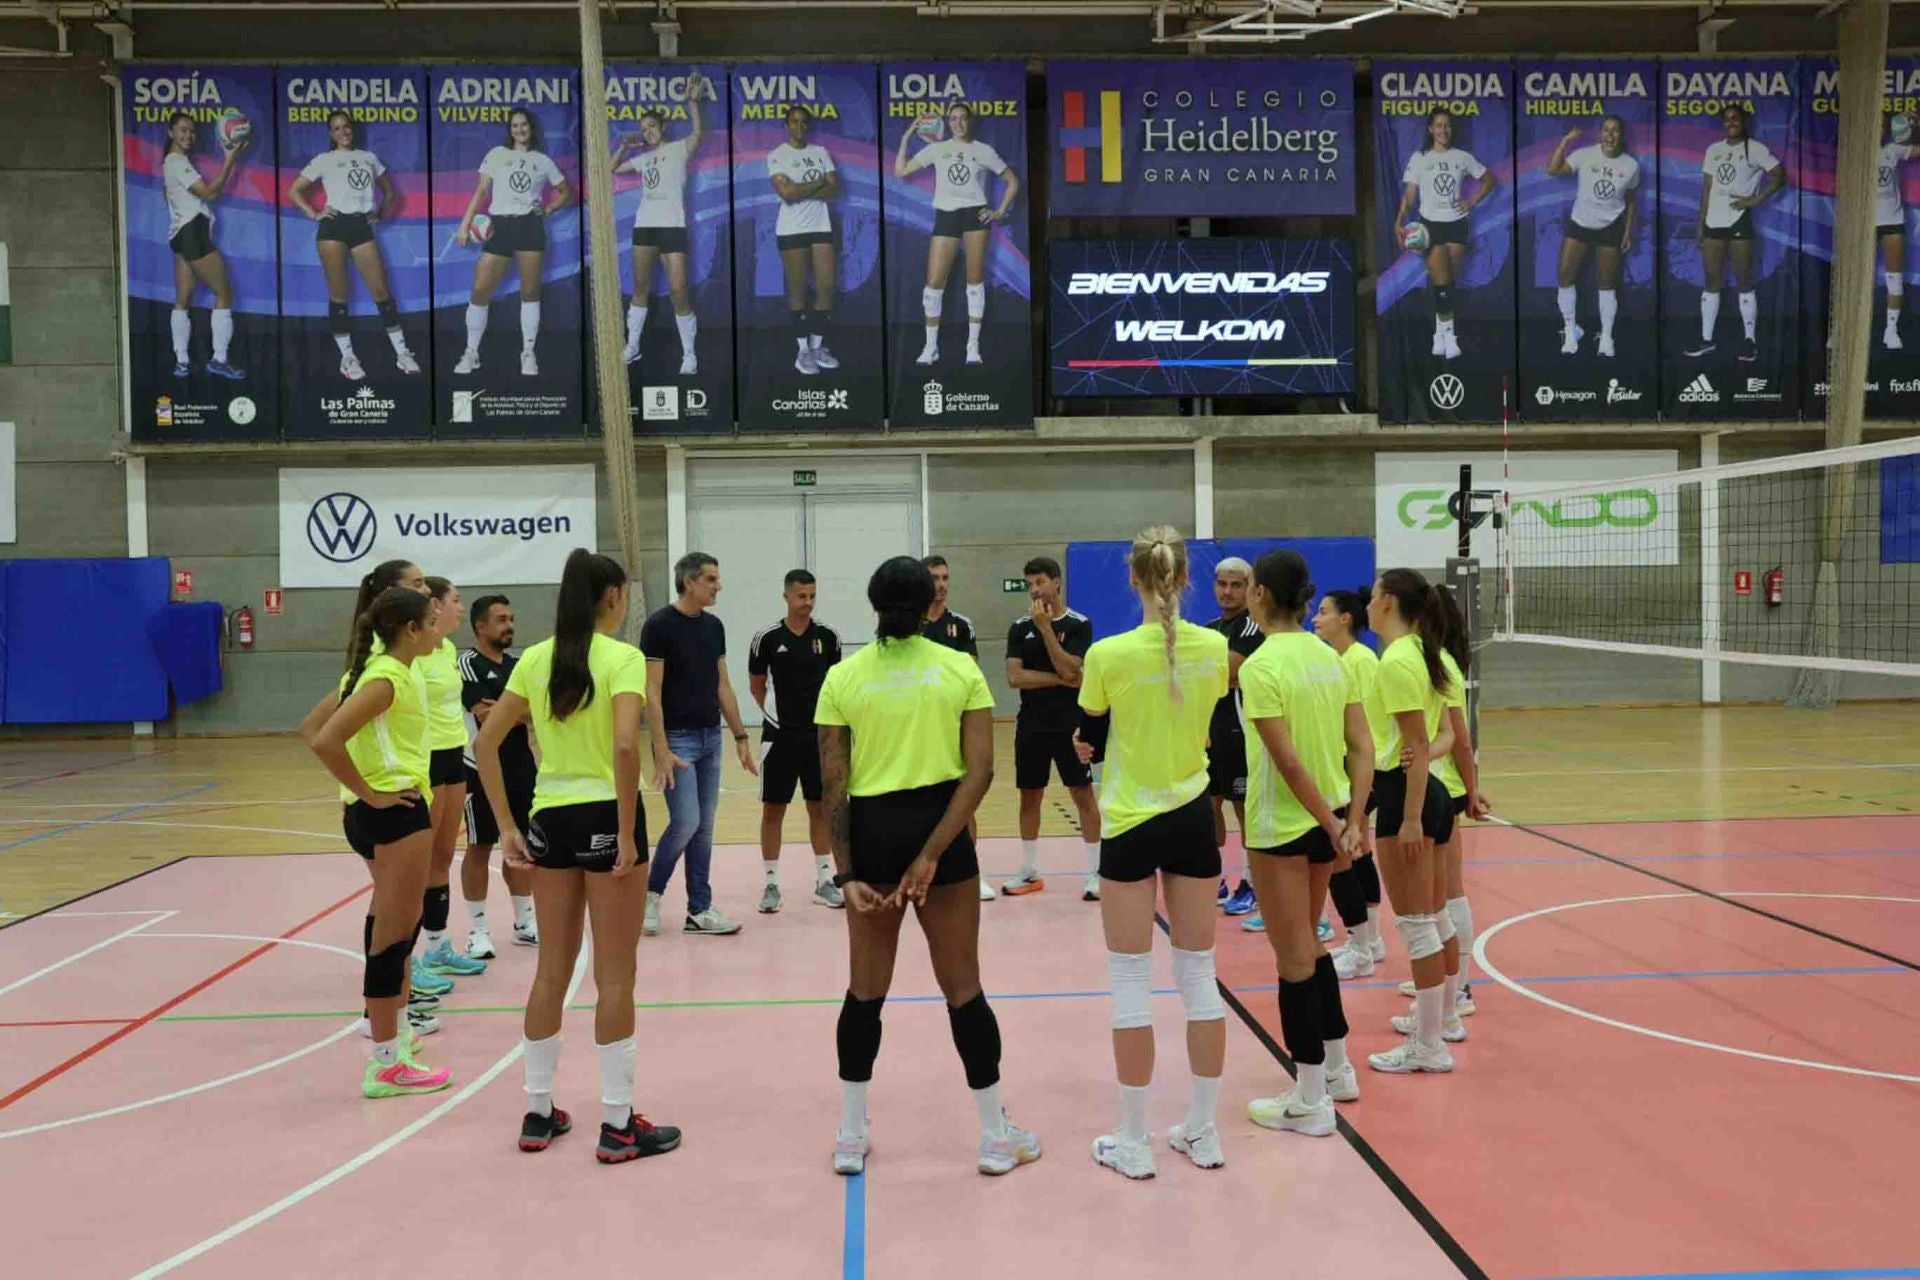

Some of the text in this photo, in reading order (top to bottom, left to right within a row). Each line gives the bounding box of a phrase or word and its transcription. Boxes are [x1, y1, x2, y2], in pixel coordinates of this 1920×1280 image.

[134, 71, 221, 103] SOFÍA
[288, 78, 418, 104] CANDELA
[438, 78, 570, 103] ADRIANI
[740, 75, 816, 100] WIN
[889, 73, 965, 98] LOLA
[1380, 72, 1504, 98] CLAUDIA
[1524, 72, 1647, 98] CAMILA
[1667, 71, 1790, 96] DAYANA
[1143, 90, 1337, 108] COLEGIO
[1526, 100, 1604, 115] HIRUELA
[1142, 116, 1338, 163] Heidelberg
[1144, 168, 1337, 182] GRAN CANARIA
[1067, 271, 1331, 294] BIENVENIDAS
[1114, 319, 1286, 341] WELKOM
[321, 397, 396, 410] Las Palmas
[772, 399, 826, 410] Canarias
[798, 389, 826, 400] Islas
[945, 392, 990, 402] Gobierno
[1678, 391, 1720, 402] adidas
[946, 402, 999, 411] de Canarias
[394, 512, 571, 541] Volkswagen
